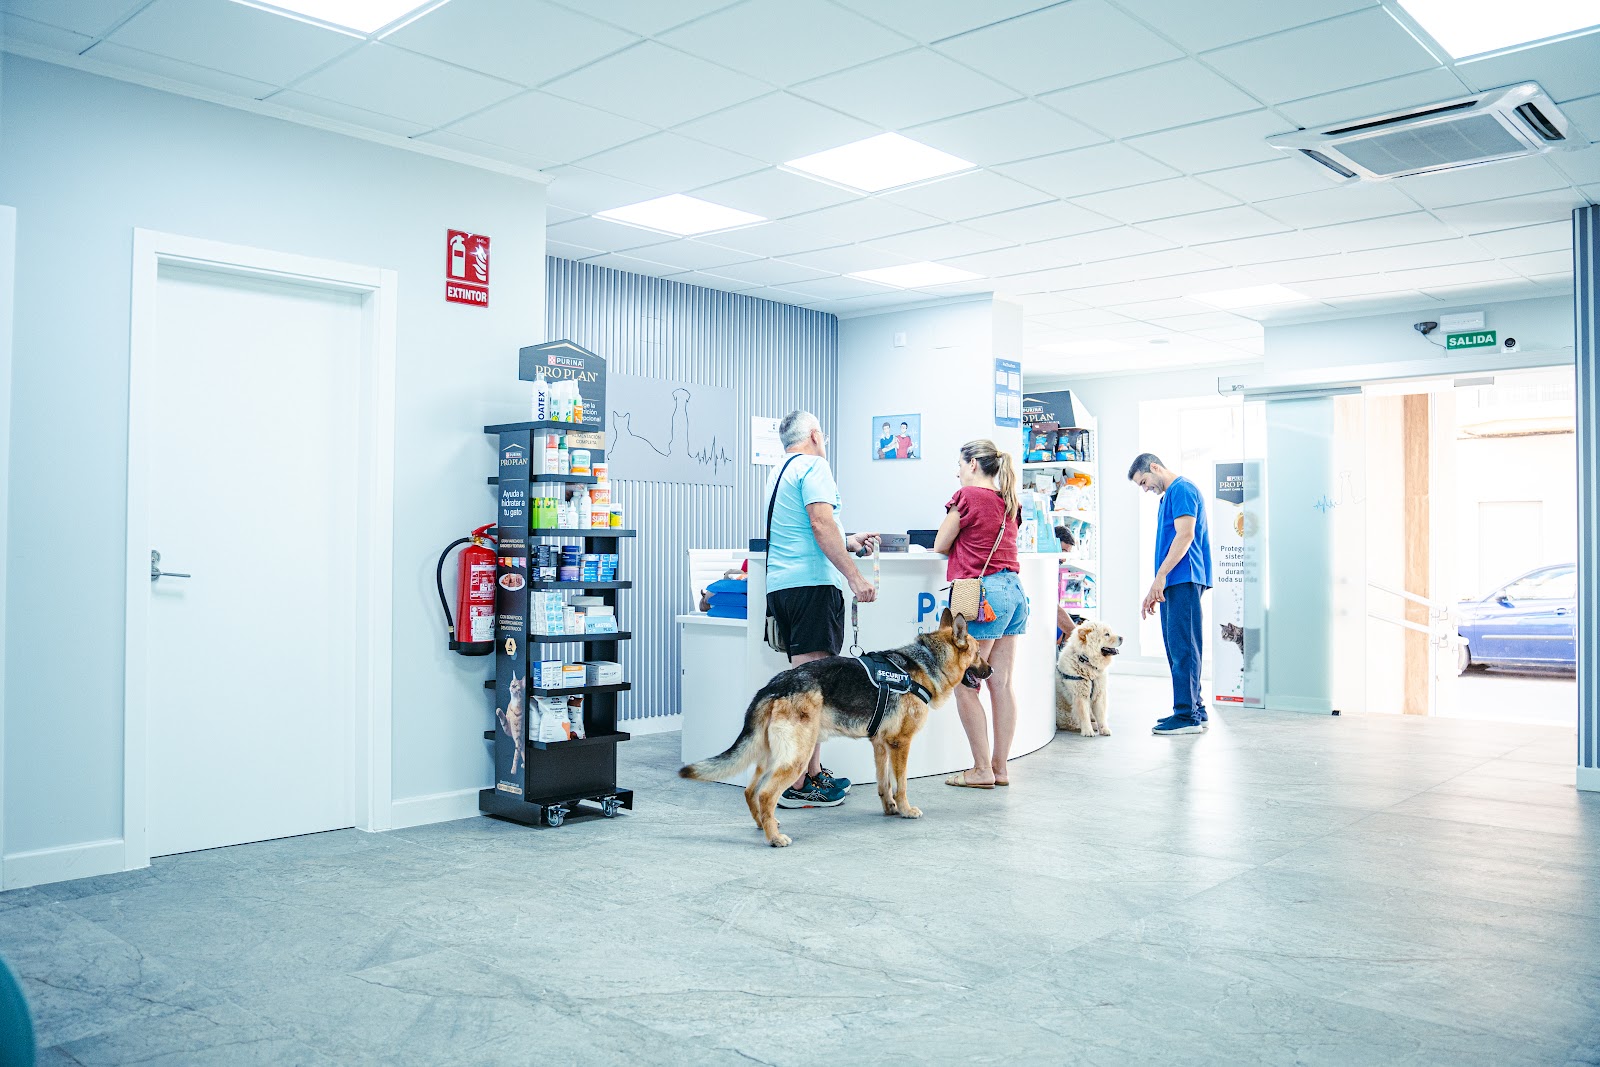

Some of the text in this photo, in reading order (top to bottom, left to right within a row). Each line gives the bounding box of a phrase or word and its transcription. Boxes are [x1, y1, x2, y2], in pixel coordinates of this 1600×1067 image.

[447, 286, 487, 303] EXTINTOR
[1449, 335, 1494, 346] SALIDA
[556, 357, 583, 367] PURINA
[534, 364, 597, 383] PRO PLAN
[537, 391, 545, 420] OATEX
[1028, 413, 1054, 422] PLAN
[500, 458, 527, 467] PRO PLAN
[502, 489, 524, 499] Ayuda a
[501, 498, 521, 507] hidratar
[503, 508, 523, 518] tu gato
[1218, 575, 1233, 583] toda
[877, 669, 909, 681] SECURITY
